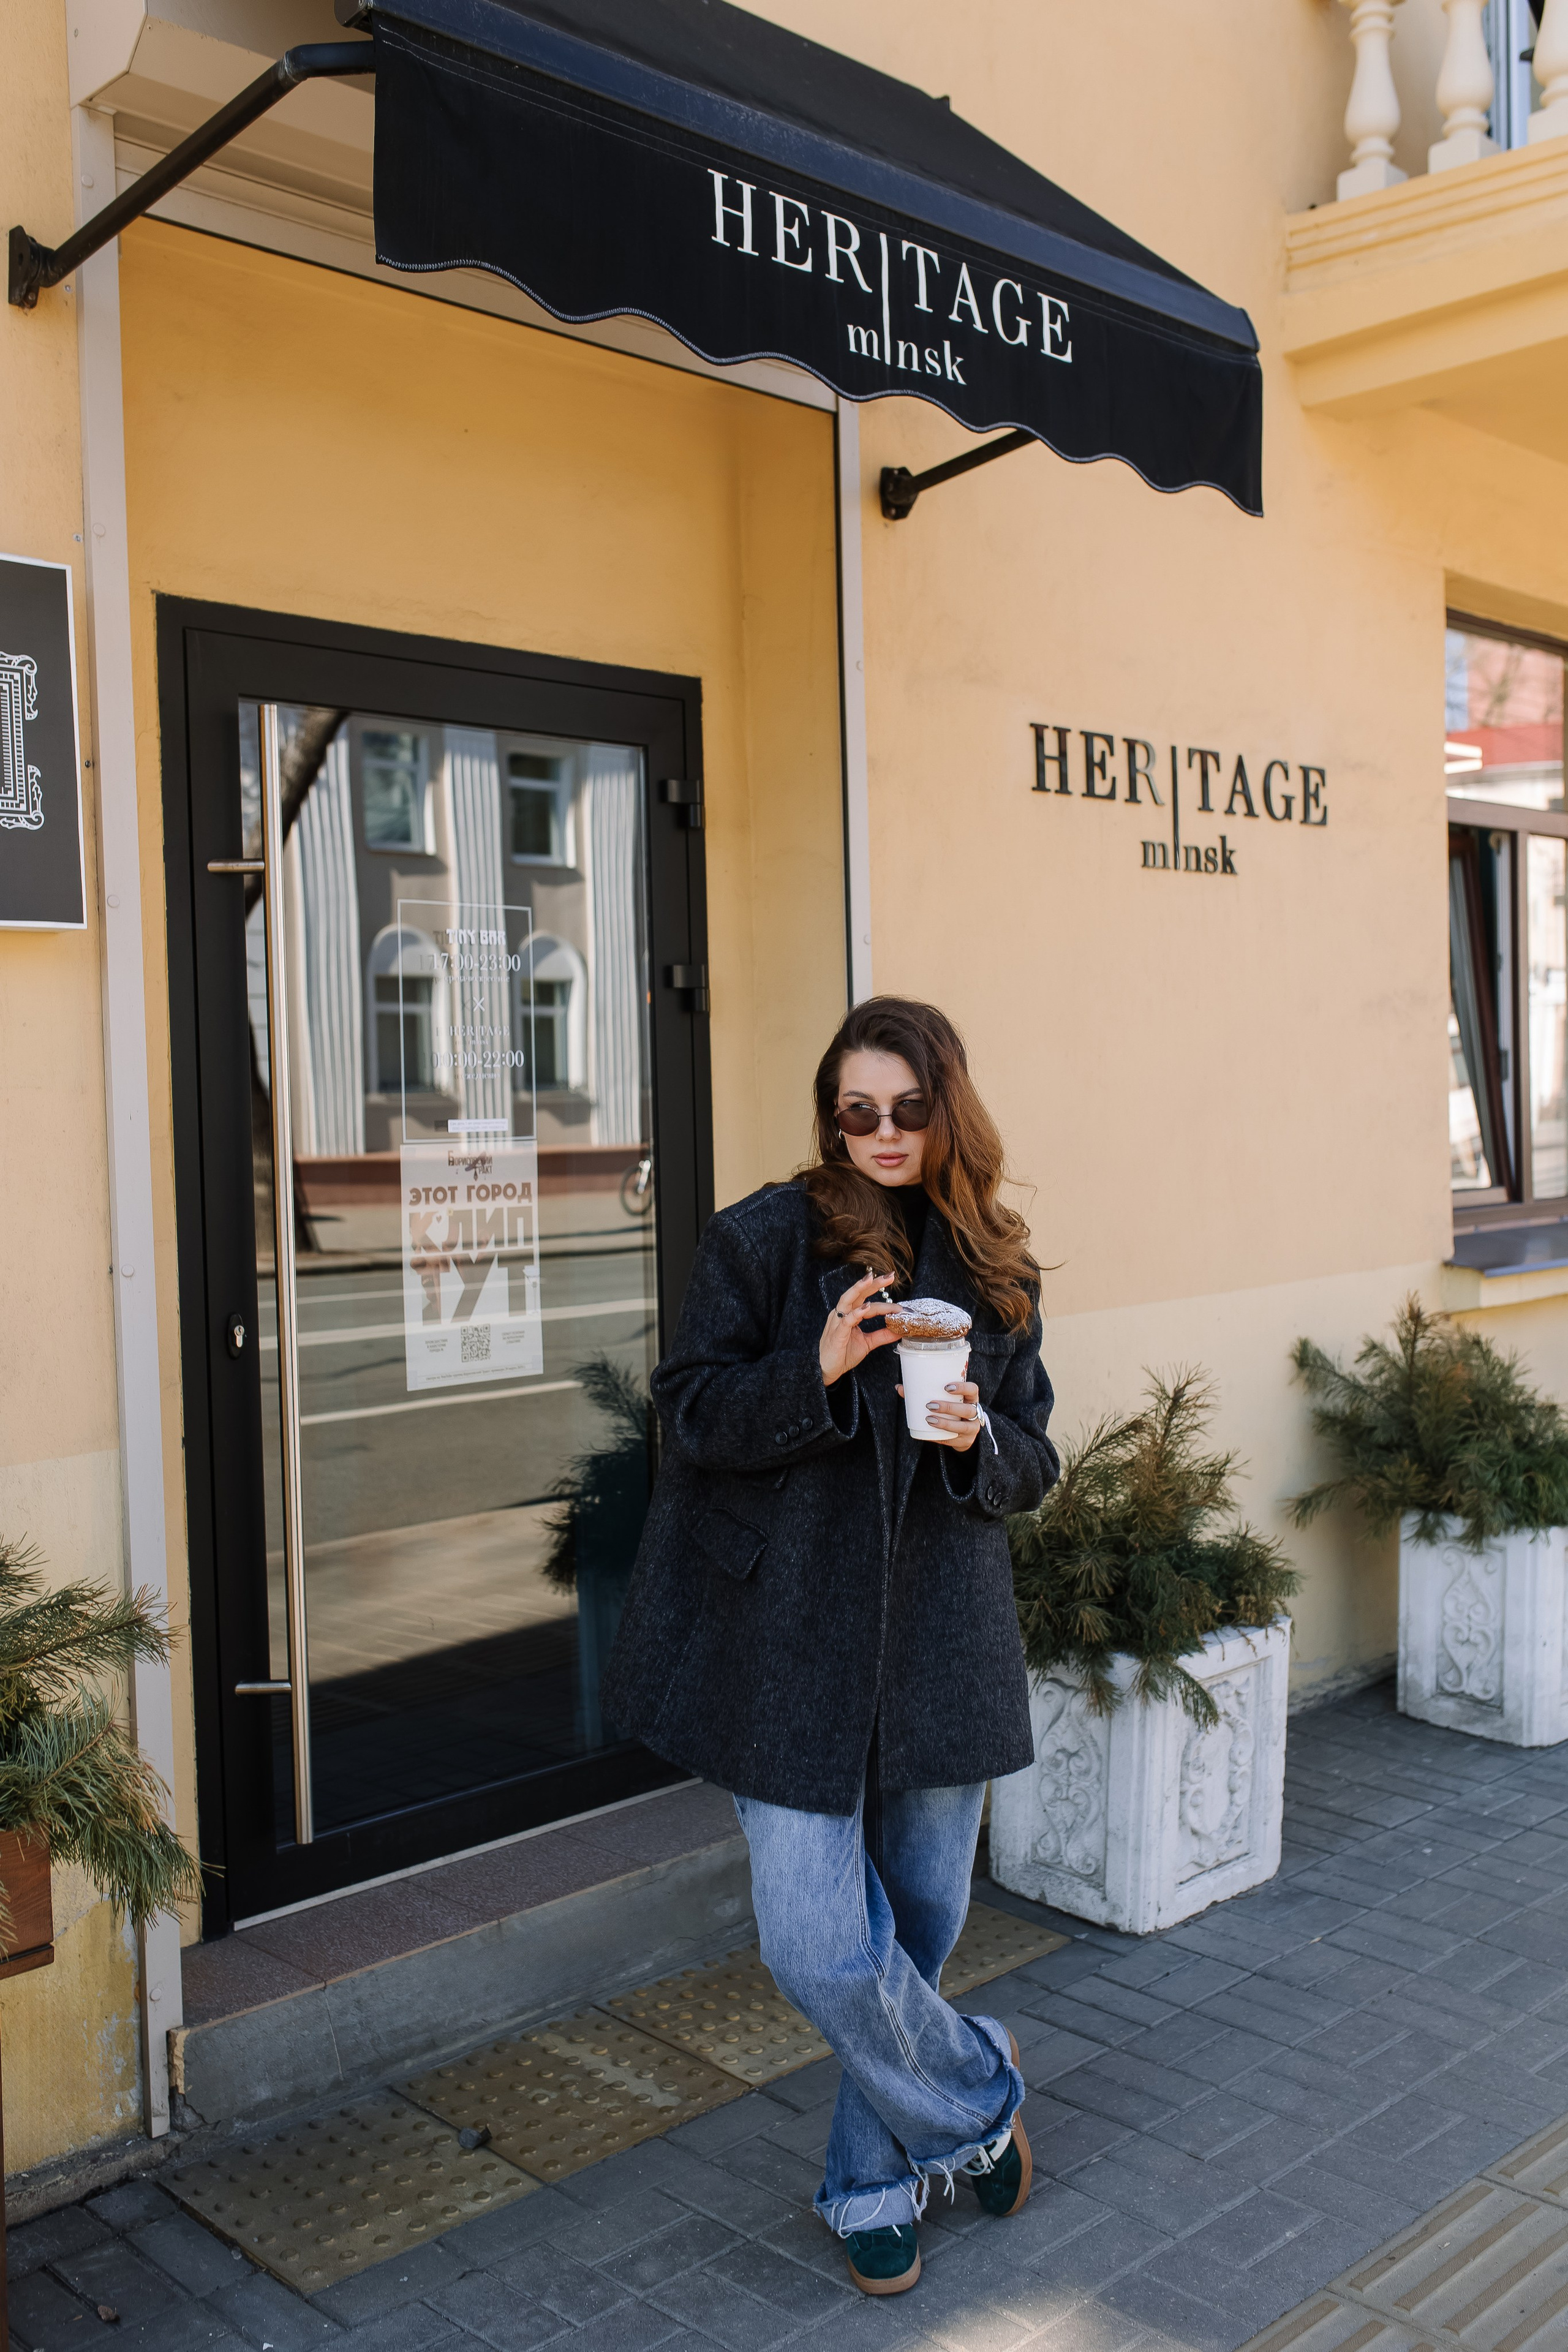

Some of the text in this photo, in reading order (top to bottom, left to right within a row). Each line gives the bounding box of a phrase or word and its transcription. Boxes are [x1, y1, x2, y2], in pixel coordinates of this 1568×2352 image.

[707, 168, 1072, 363] HERITAGE
[1030, 722, 1329, 827] HERITAGE
[446, 928, 507, 946] TINY BAR
[432, 952, 521, 972] 17:00-23:00
[449, 1025, 510, 1037] HERITAGE
[435, 1049, 525, 1068] 10:00-22:00
[409, 1182, 533, 1206] ЭТОТ ГОРОД
[409, 1205, 533, 1254] КЛИП
[410, 1248, 535, 1328] ТУТ
